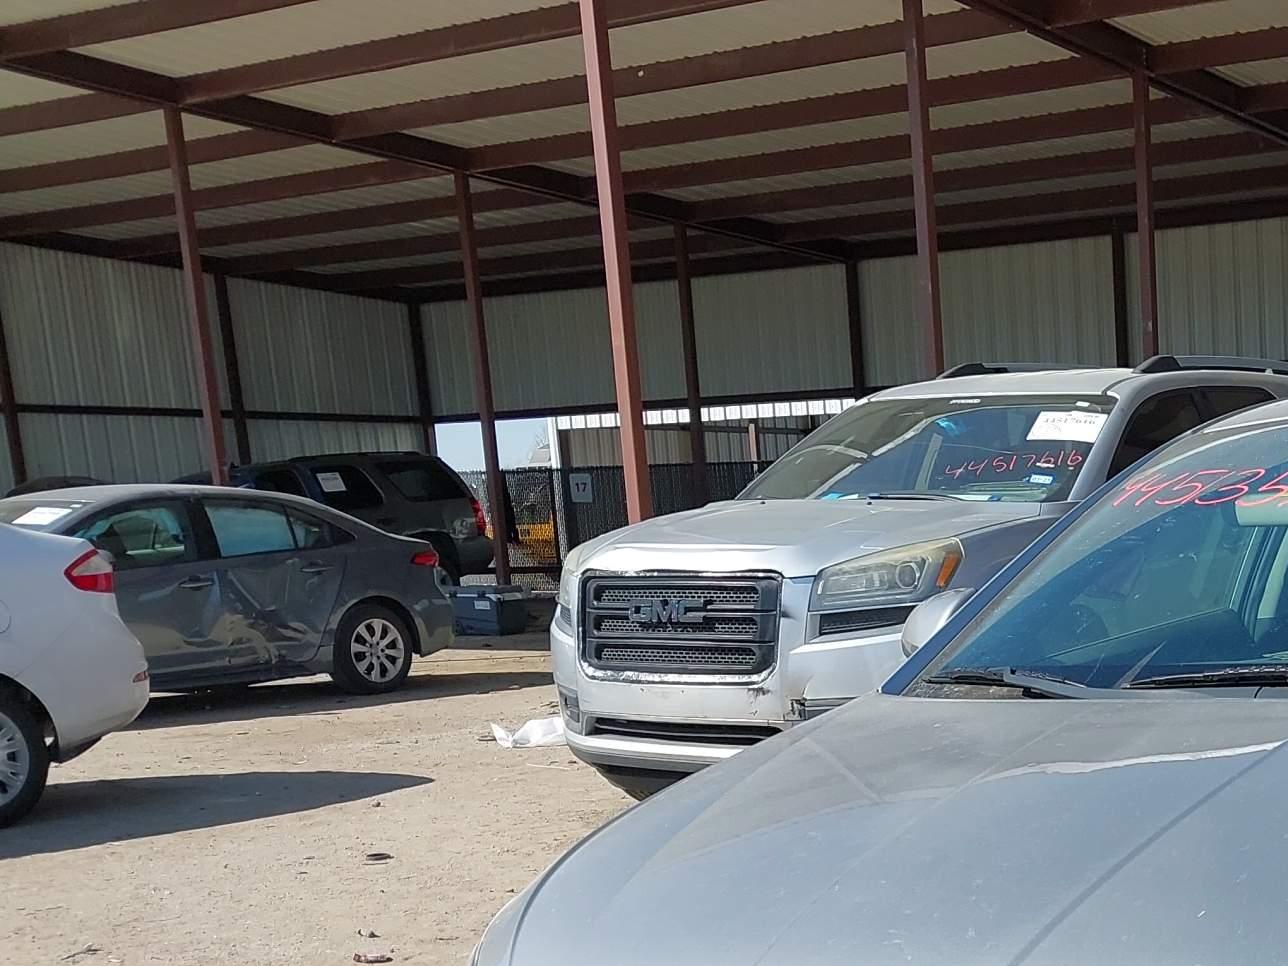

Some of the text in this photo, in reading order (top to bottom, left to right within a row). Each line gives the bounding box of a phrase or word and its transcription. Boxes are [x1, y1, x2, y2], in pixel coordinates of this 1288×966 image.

[945, 450, 1083, 480] 44517616
[575, 482, 587, 493] 17
[628, 600, 703, 623] GMC
